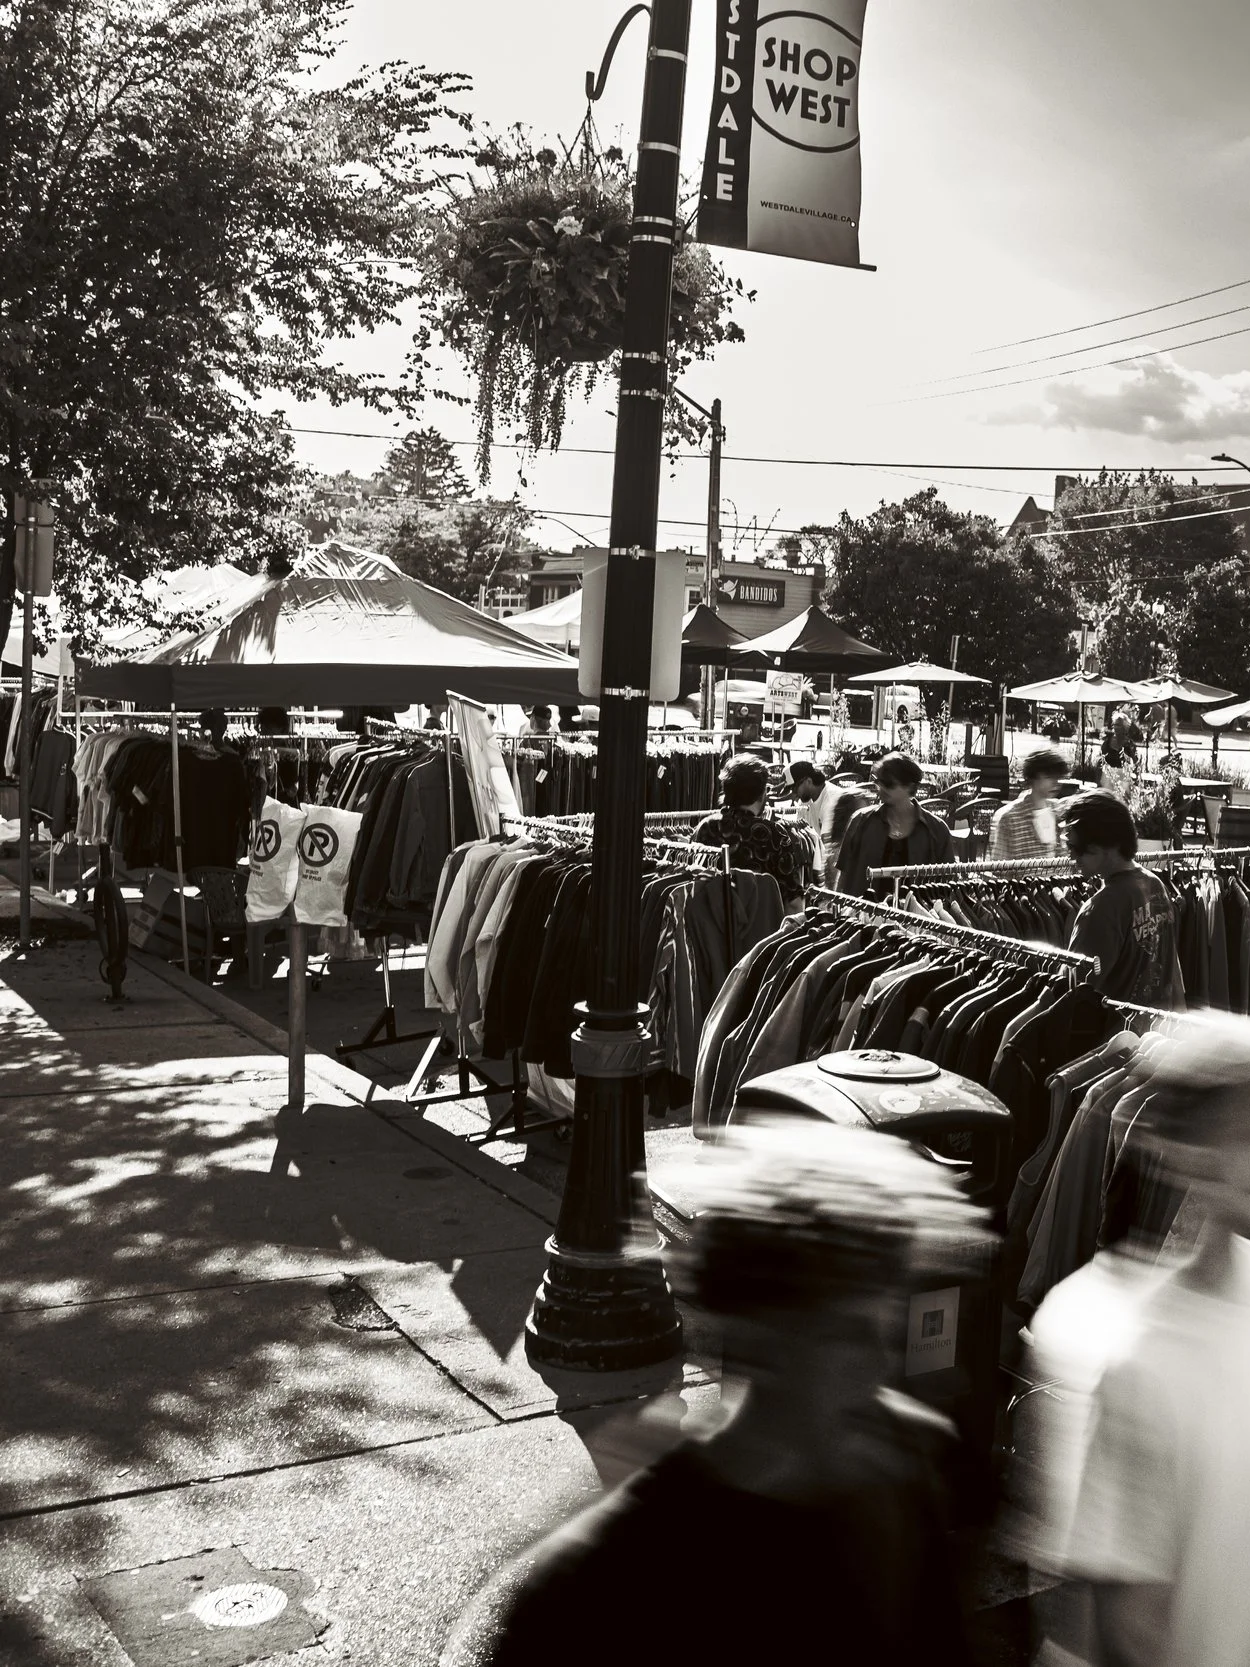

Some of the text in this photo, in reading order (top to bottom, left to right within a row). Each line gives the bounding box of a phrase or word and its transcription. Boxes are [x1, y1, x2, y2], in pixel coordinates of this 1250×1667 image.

[762, 36, 857, 87] SHOP
[765, 78, 851, 128] WEST
[760, 200, 851, 223] WESTDALEVILLAGE.CA
[740, 585, 778, 602] BANDIDOS
[910, 1336, 952, 1353] Hamilton
